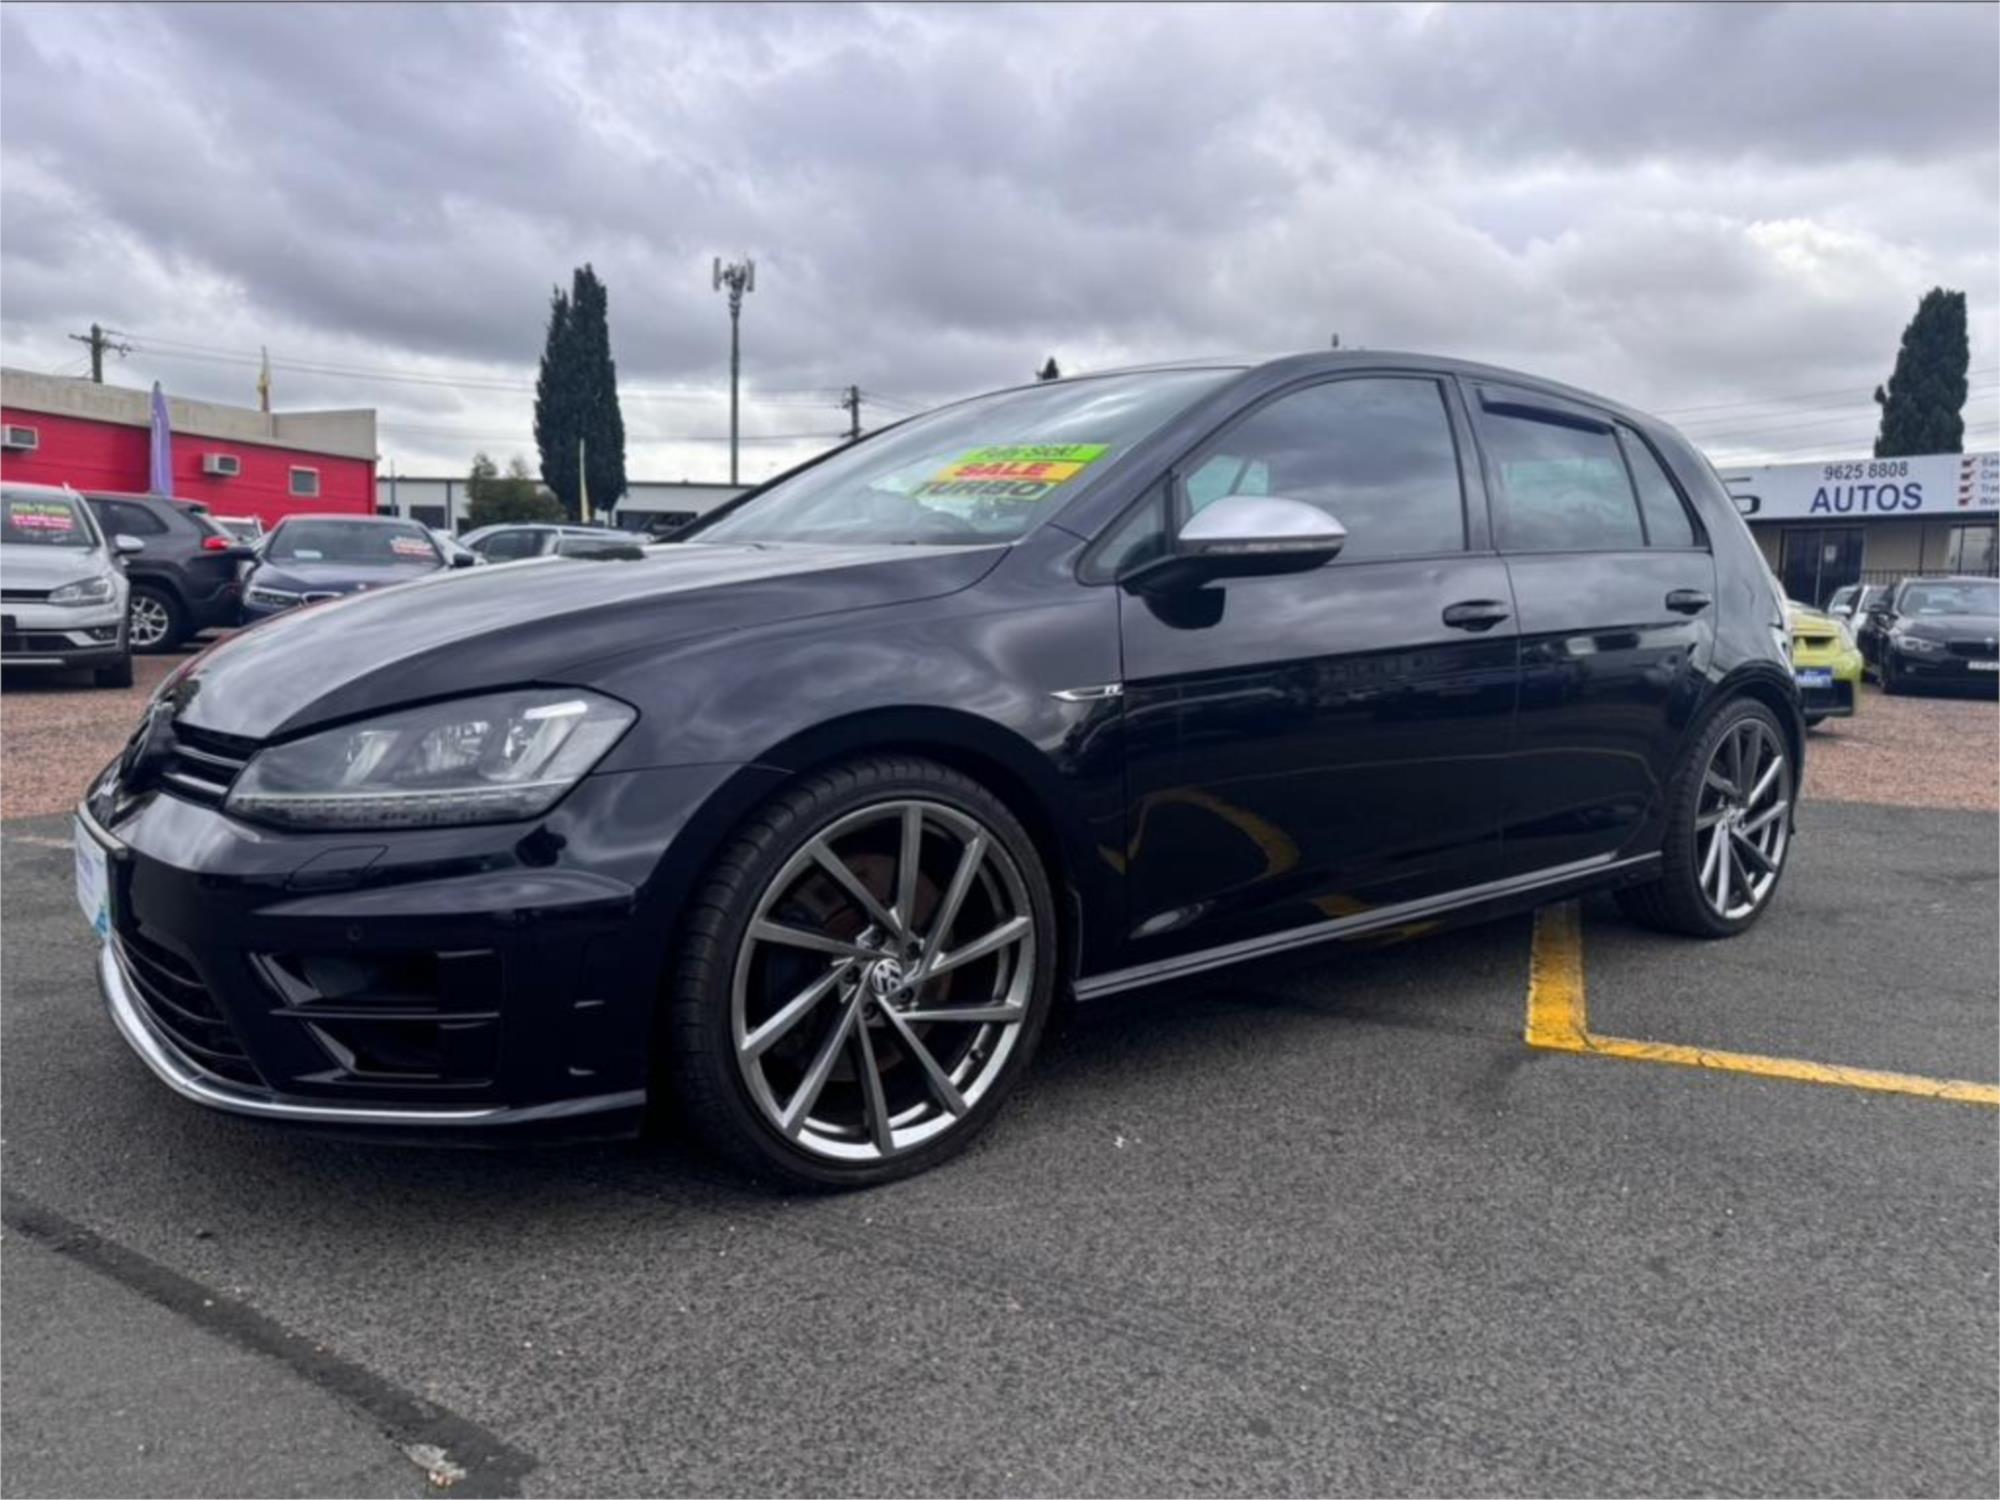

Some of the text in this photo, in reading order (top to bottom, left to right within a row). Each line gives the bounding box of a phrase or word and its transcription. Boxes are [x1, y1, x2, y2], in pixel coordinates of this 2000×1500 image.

[953, 462, 1055, 477] SALE
[1824, 461, 1908, 480] 9625 8808
[914, 482, 1048, 497] TURBO
[1810, 482, 1923, 513] AUTOS
